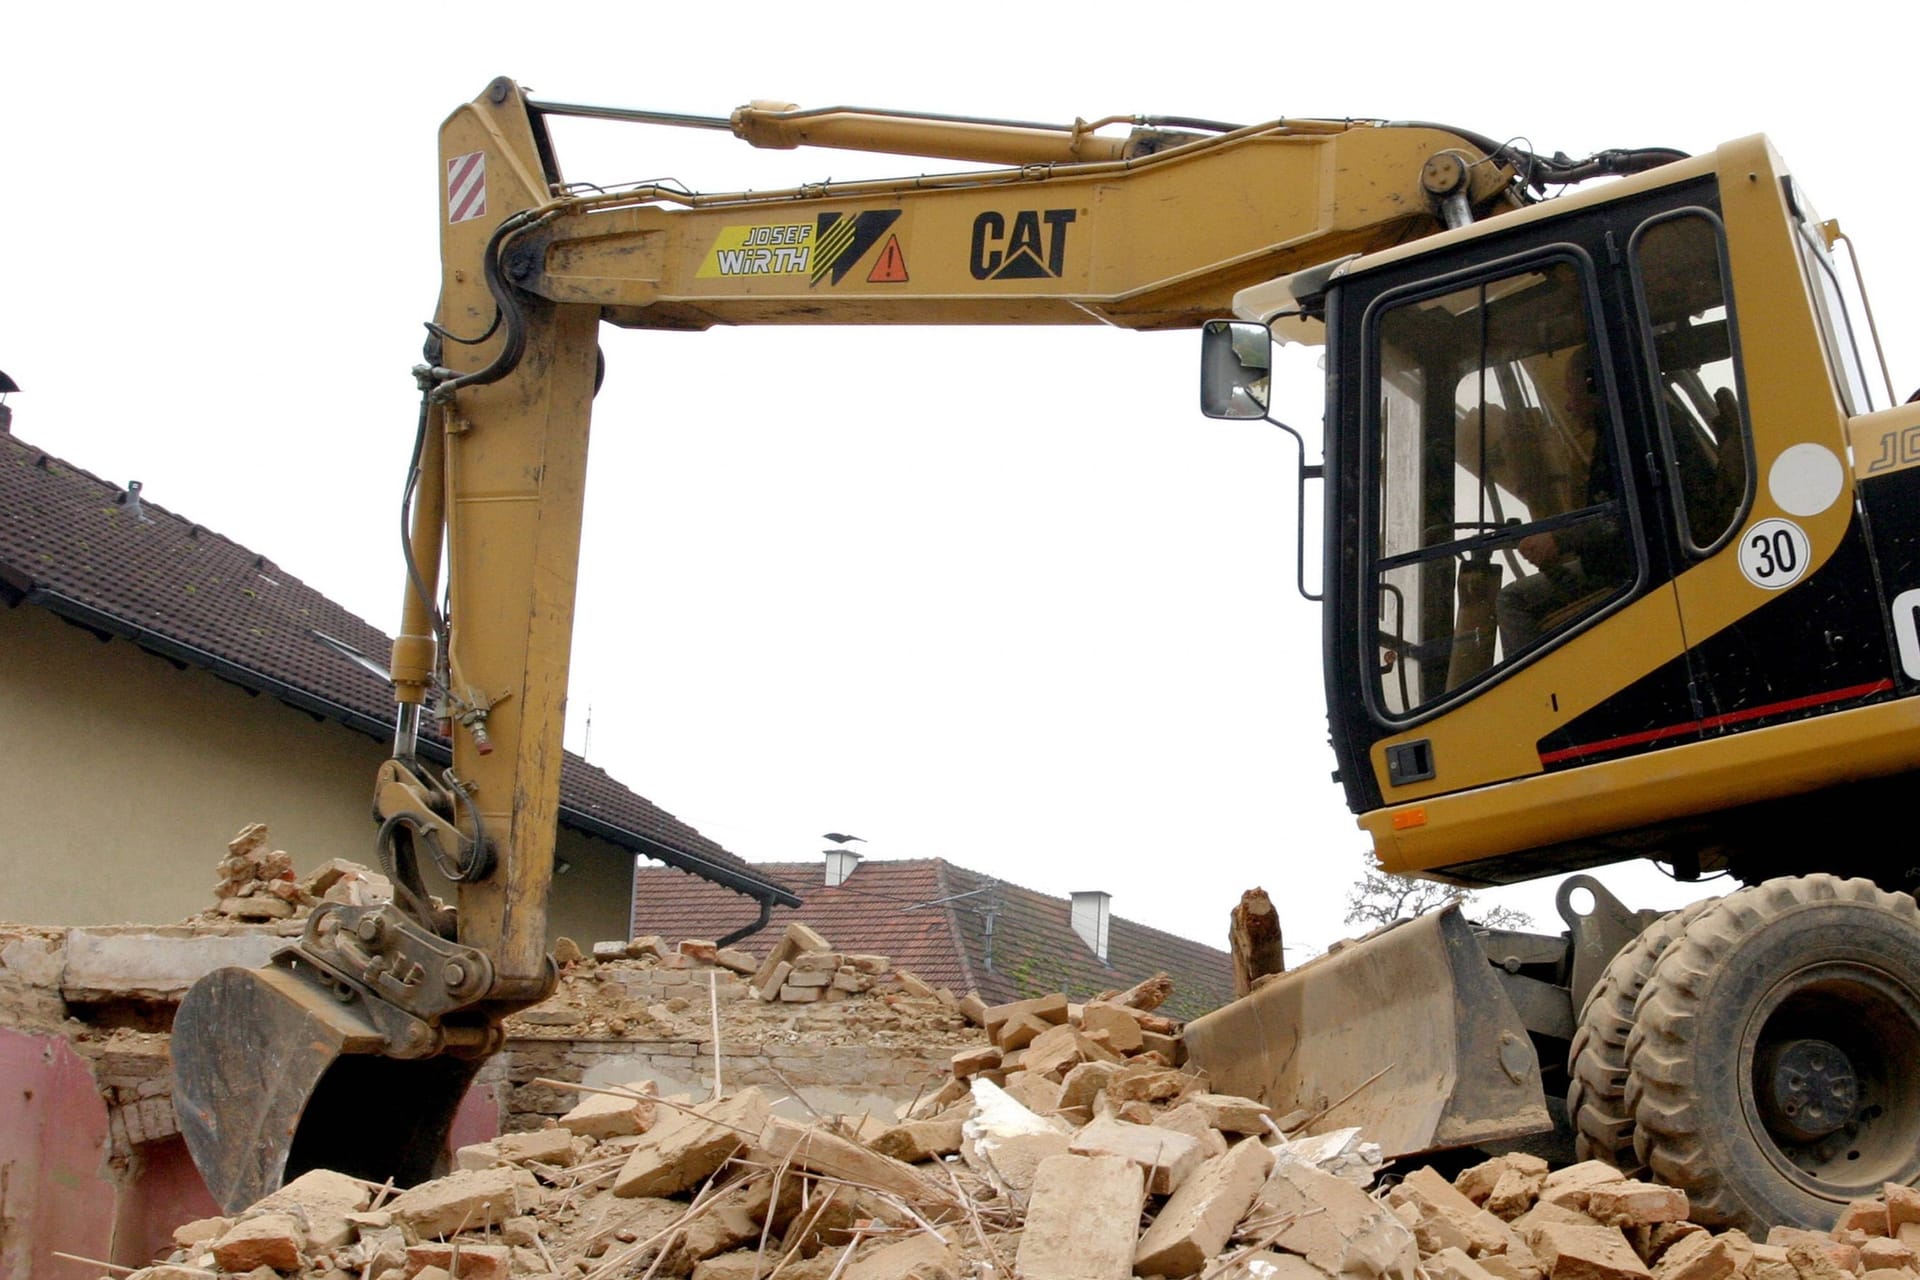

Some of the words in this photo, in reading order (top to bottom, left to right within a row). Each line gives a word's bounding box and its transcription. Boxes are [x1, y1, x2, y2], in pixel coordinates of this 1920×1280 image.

[743, 225, 812, 246] JOSEF
[970, 208, 1077, 280] CAT
[1752, 529, 1796, 578] 30
